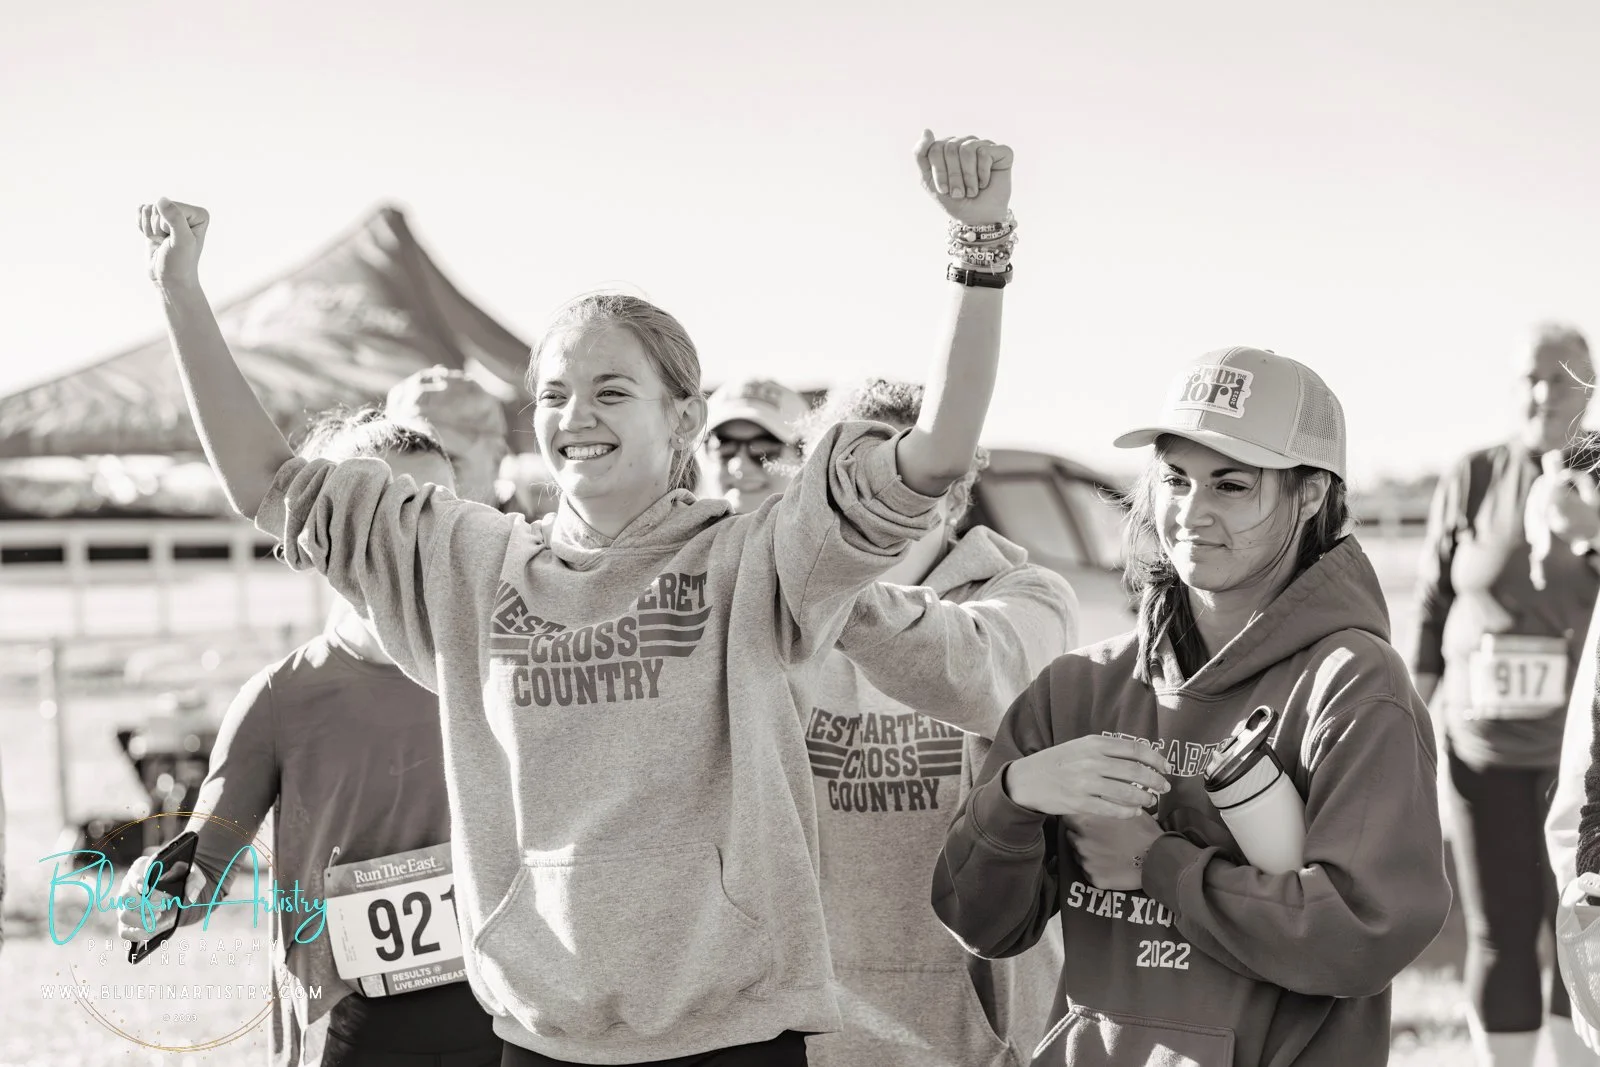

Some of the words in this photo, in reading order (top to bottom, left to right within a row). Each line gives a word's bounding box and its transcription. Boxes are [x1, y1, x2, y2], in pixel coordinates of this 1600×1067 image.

[531, 616, 637, 664] CROSS
[513, 658, 664, 707] COUNTRY
[1495, 660, 1549, 696] 917
[828, 778, 940, 812] COUNTRY
[1136, 940, 1191, 970] 2022
[392, 967, 432, 982] RESULTS
